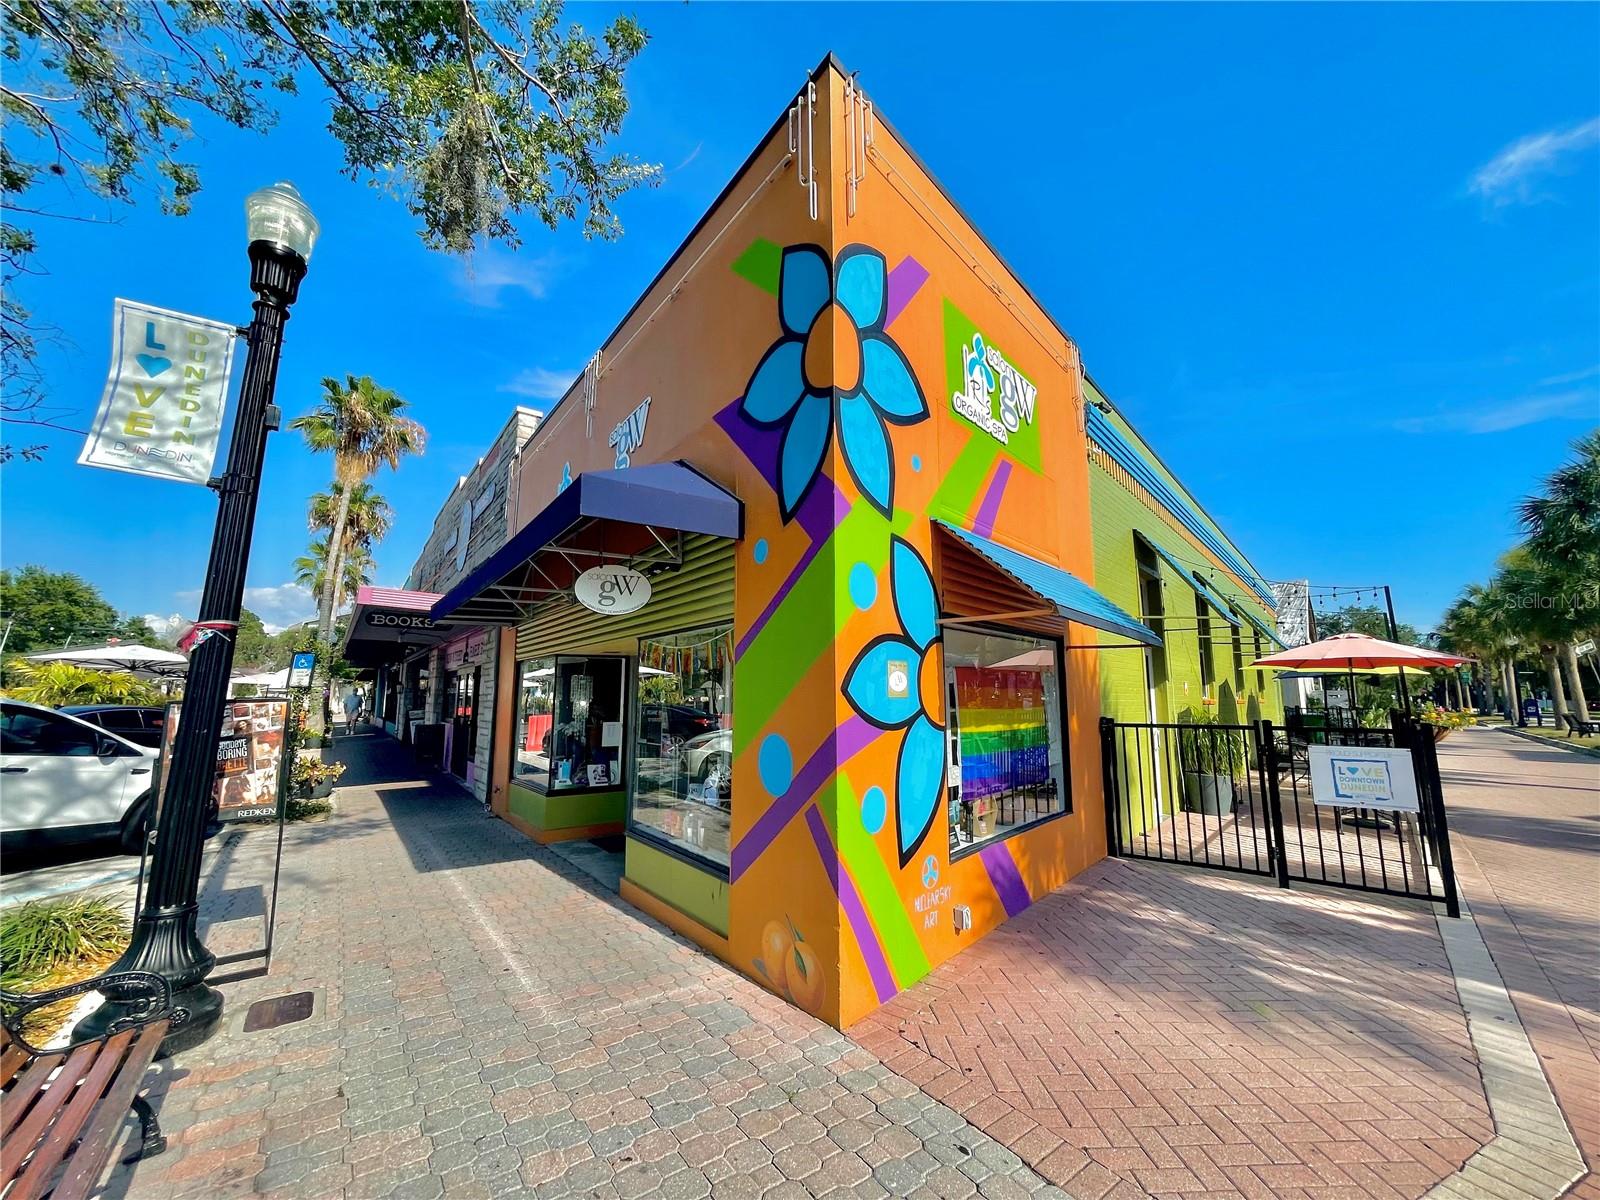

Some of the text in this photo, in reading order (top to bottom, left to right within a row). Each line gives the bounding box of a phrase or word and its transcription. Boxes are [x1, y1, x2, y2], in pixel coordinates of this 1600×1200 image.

[171, 331, 210, 445] DUNEDIN
[955, 396, 1007, 440] ORGANIC SPA
[371, 613, 435, 628] BOOKS
[217, 747, 248, 760] BORING
[1340, 776, 1385, 785] DOWNTOWN
[1341, 783, 1386, 793] DUNEDIN
[238, 807, 277, 818] REDKEN
[925, 911, 938, 929] ART
